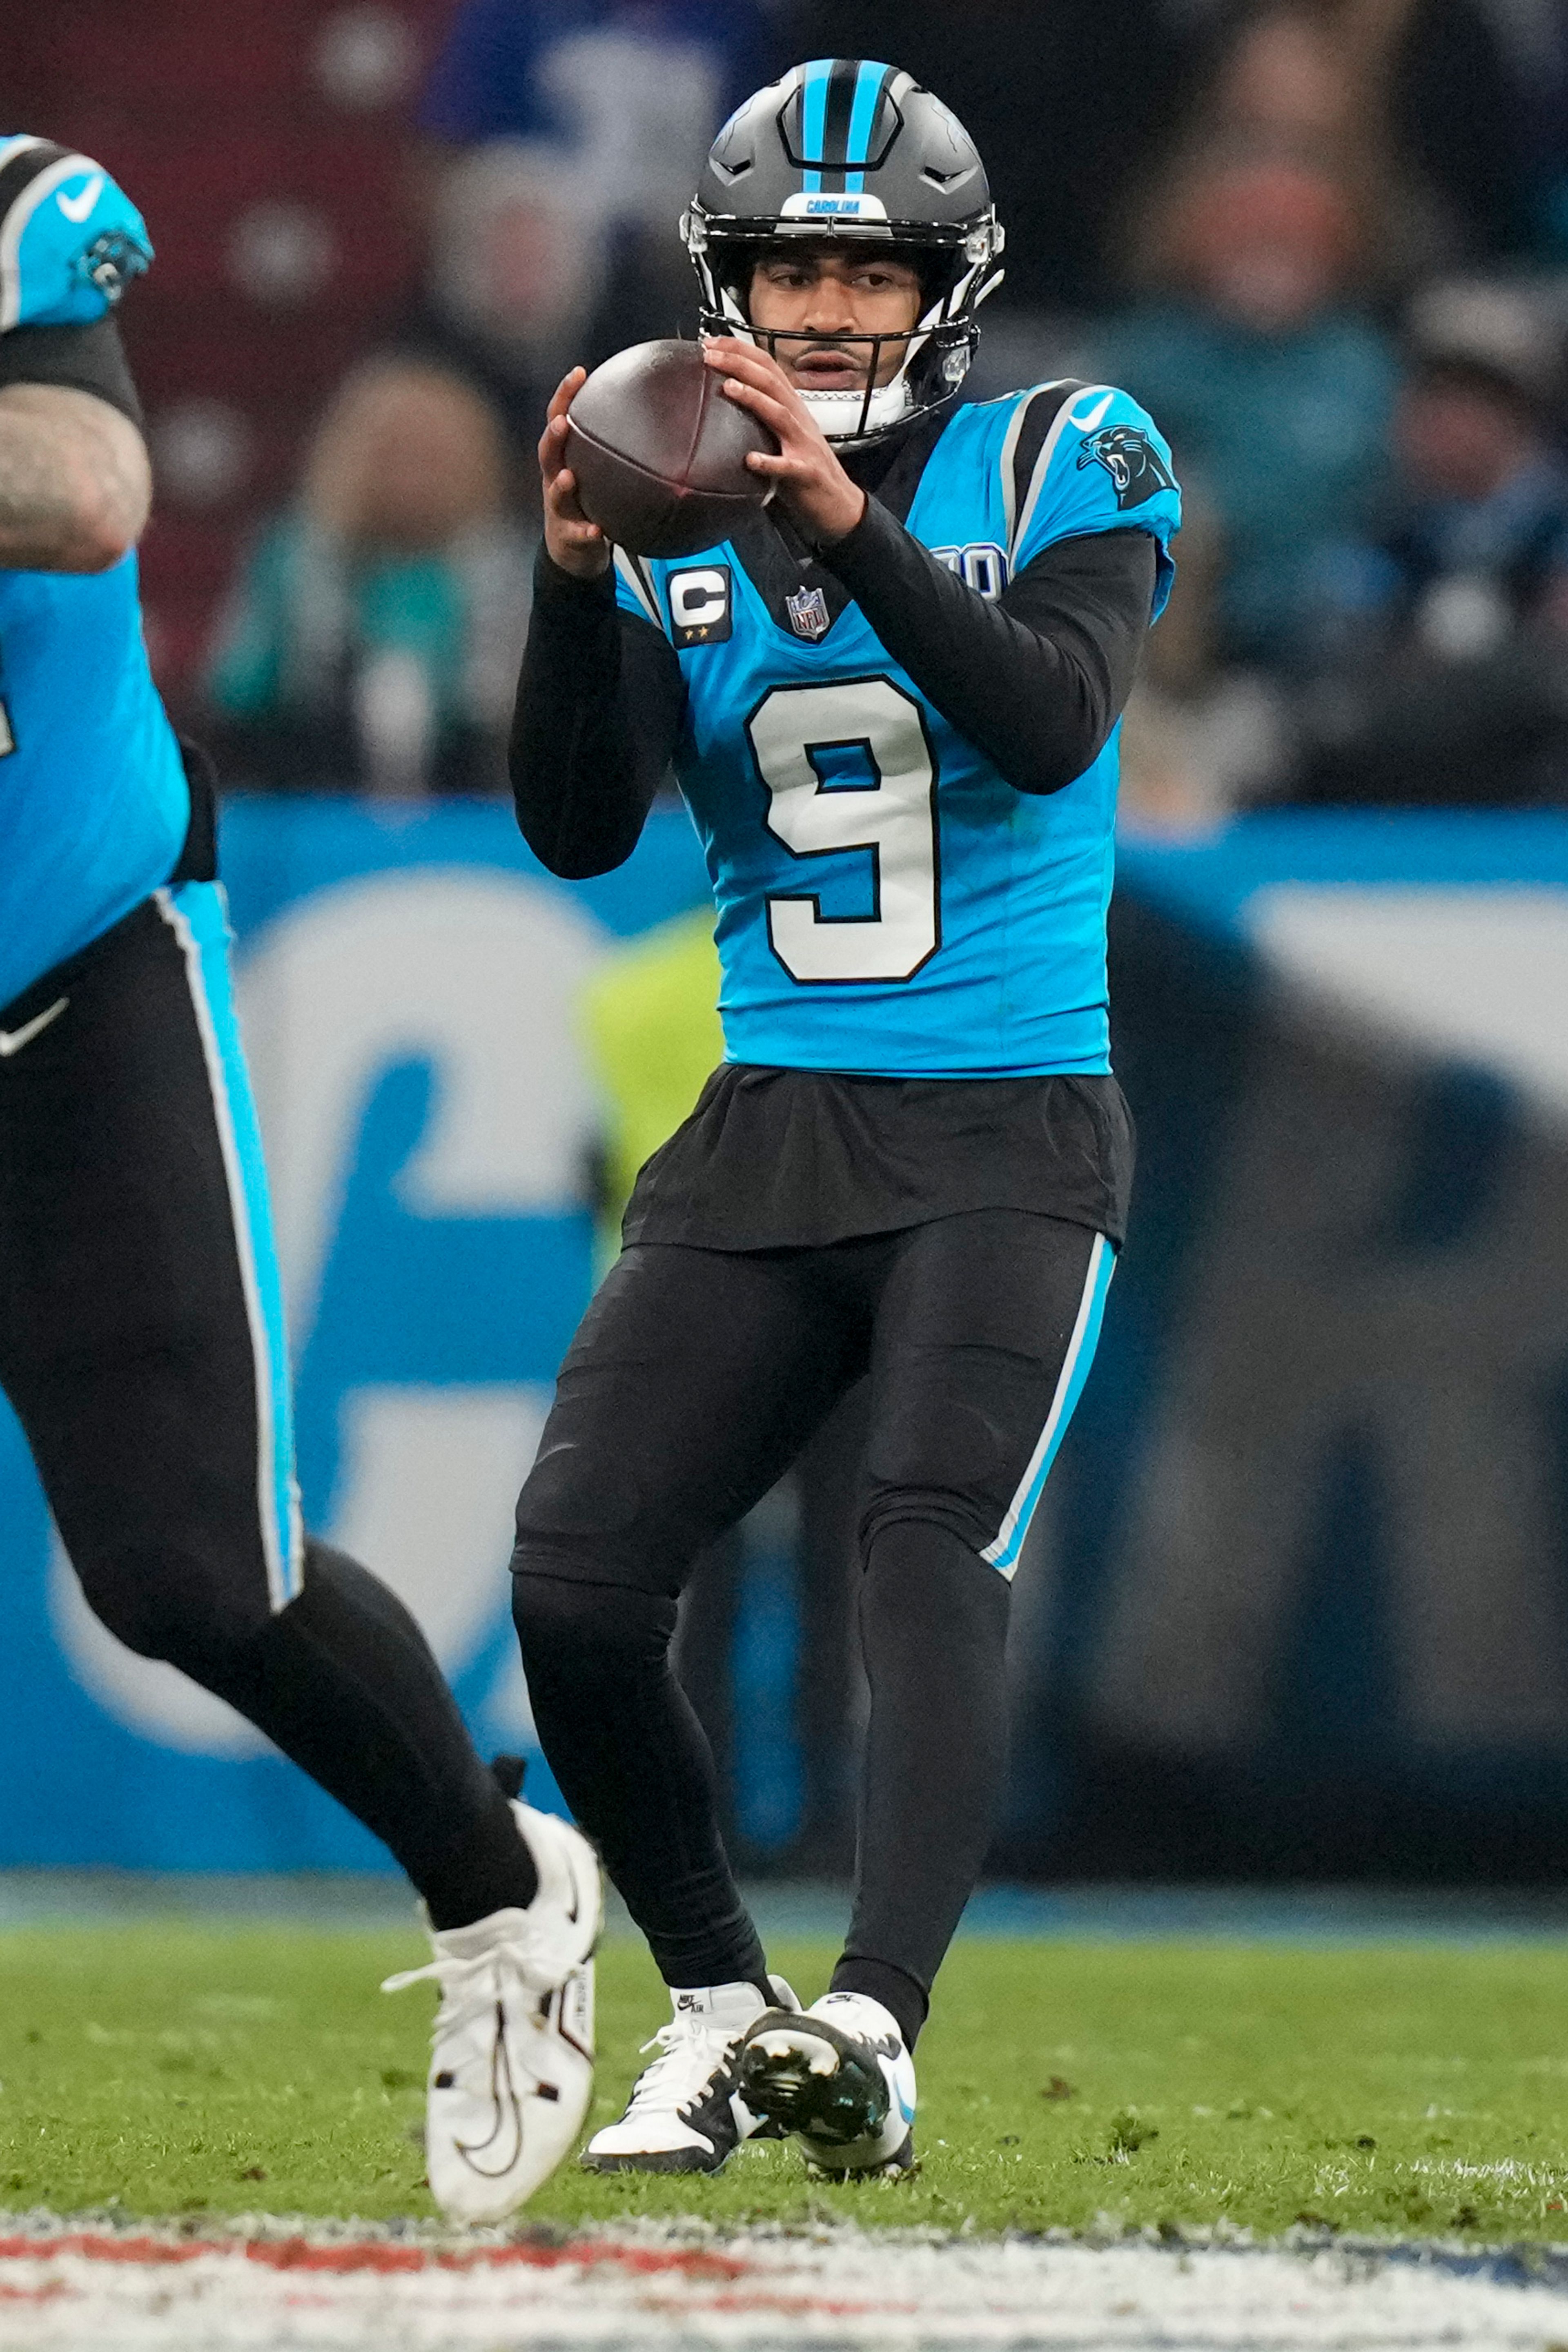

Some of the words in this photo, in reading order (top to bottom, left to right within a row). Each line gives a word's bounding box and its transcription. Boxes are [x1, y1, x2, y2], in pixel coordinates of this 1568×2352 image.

[806, 200, 860, 214] CAROLINA
[670, 570, 725, 628] C
[792, 608, 825, 631] NFL
[743, 673, 942, 987] 9
